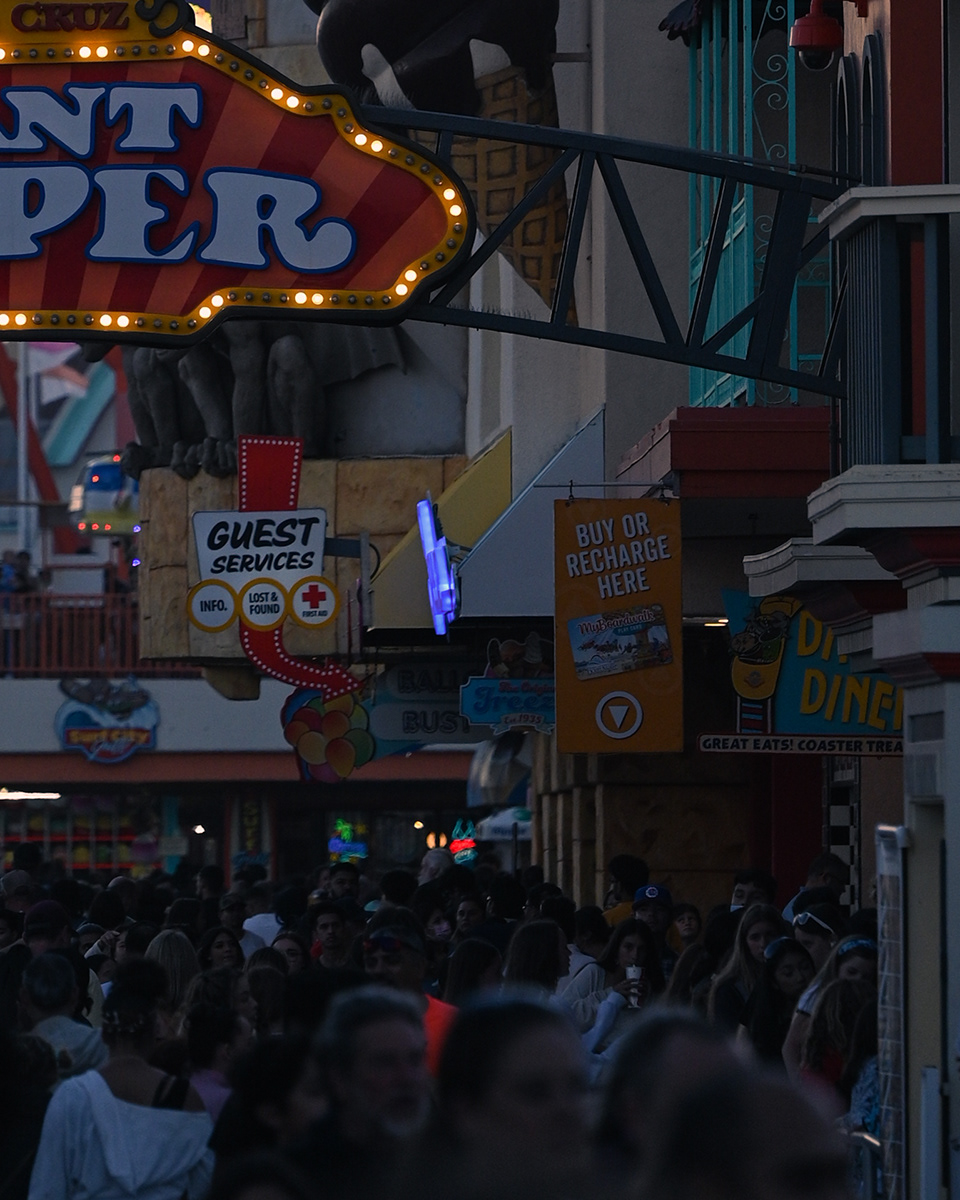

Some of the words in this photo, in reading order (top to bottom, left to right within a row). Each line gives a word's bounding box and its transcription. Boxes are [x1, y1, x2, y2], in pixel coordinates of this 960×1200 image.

[11, 2, 129, 32] CRUZ
[207, 517, 320, 550] GUEST
[575, 517, 614, 548] BUY
[621, 512, 650, 538] OR
[210, 552, 315, 574] SERVICES
[566, 535, 671, 578] RECHARGE
[597, 567, 650, 599] HERE
[200, 600, 227, 612] INFO.
[249, 593, 269, 603] LOST
[270, 592, 278, 601] &
[249, 604, 280, 615] FOUND
[578, 608, 656, 635] MyBoardwalk
[797, 610, 849, 664] DI
[702, 739, 752, 750] GREAT
[754, 739, 793, 751] EATS!
[798, 740, 863, 751] COASTER
[866, 741, 903, 752] TREA
